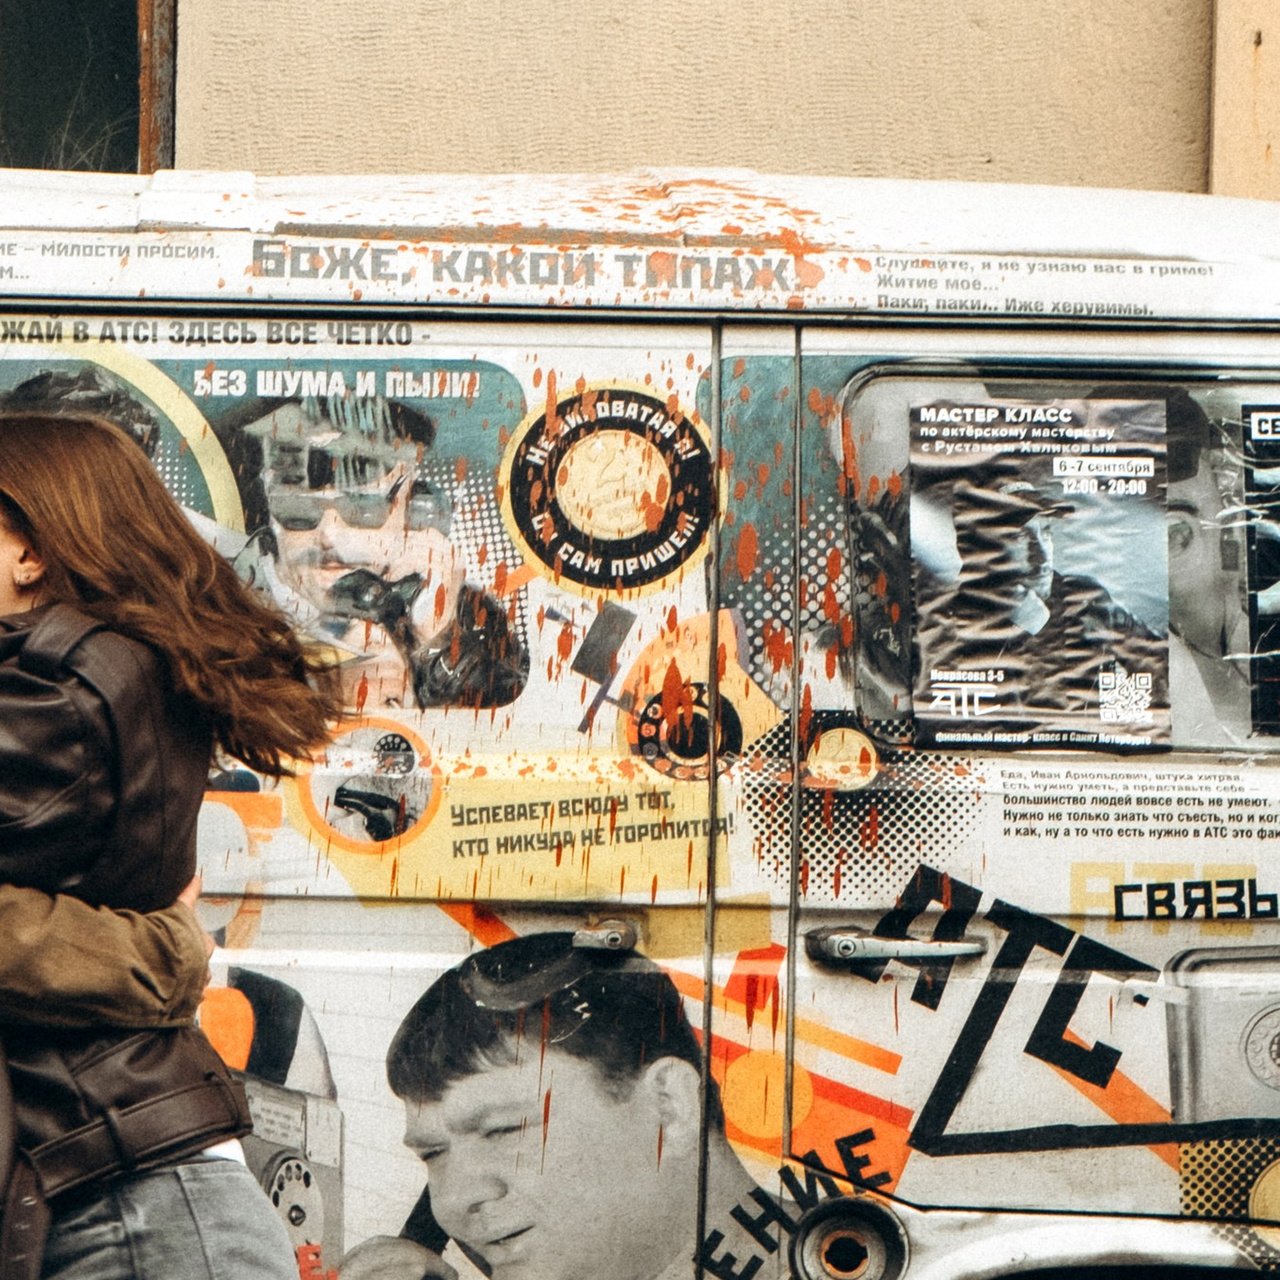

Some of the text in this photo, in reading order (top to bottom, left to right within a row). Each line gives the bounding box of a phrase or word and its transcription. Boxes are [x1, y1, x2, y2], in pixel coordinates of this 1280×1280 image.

[877, 274, 938, 290] Житие
[1005, 298, 1044, 312] Иже
[73, 321, 90, 344] В
[99, 321, 158, 344] АТС!
[169, 320, 257, 347] ЗДЕСЬ
[266, 321, 318, 345] ВСЕ
[327, 321, 413, 346] ЧЕТКО
[193, 370, 247, 396] БЕЗ
[256, 370, 346, 397] ШУМА
[355, 371, 376, 397] И
[920, 407, 1073, 423] МАСТЕР КЛАСС
[920, 427, 937, 437] по
[1031, 426, 1116, 440] мастерству
[1058, 460, 1151, 476] 6 сентября
[1061, 479, 1098, 495] 12:00
[928, 683, 1002, 719] АТС
[1031, 770, 1061, 780] Иван
[1002, 781, 1030, 791] Есть
[1003, 793, 1272, 809] большинство людей вовсе есть не умеют.
[1003, 809, 1255, 824] Нужно не только знать что съесть, но и
[1003, 826, 1253, 840] и как, ну а то что есть нужно в АТС это
[1113, 878, 1279, 922] СВЯЗЬ
